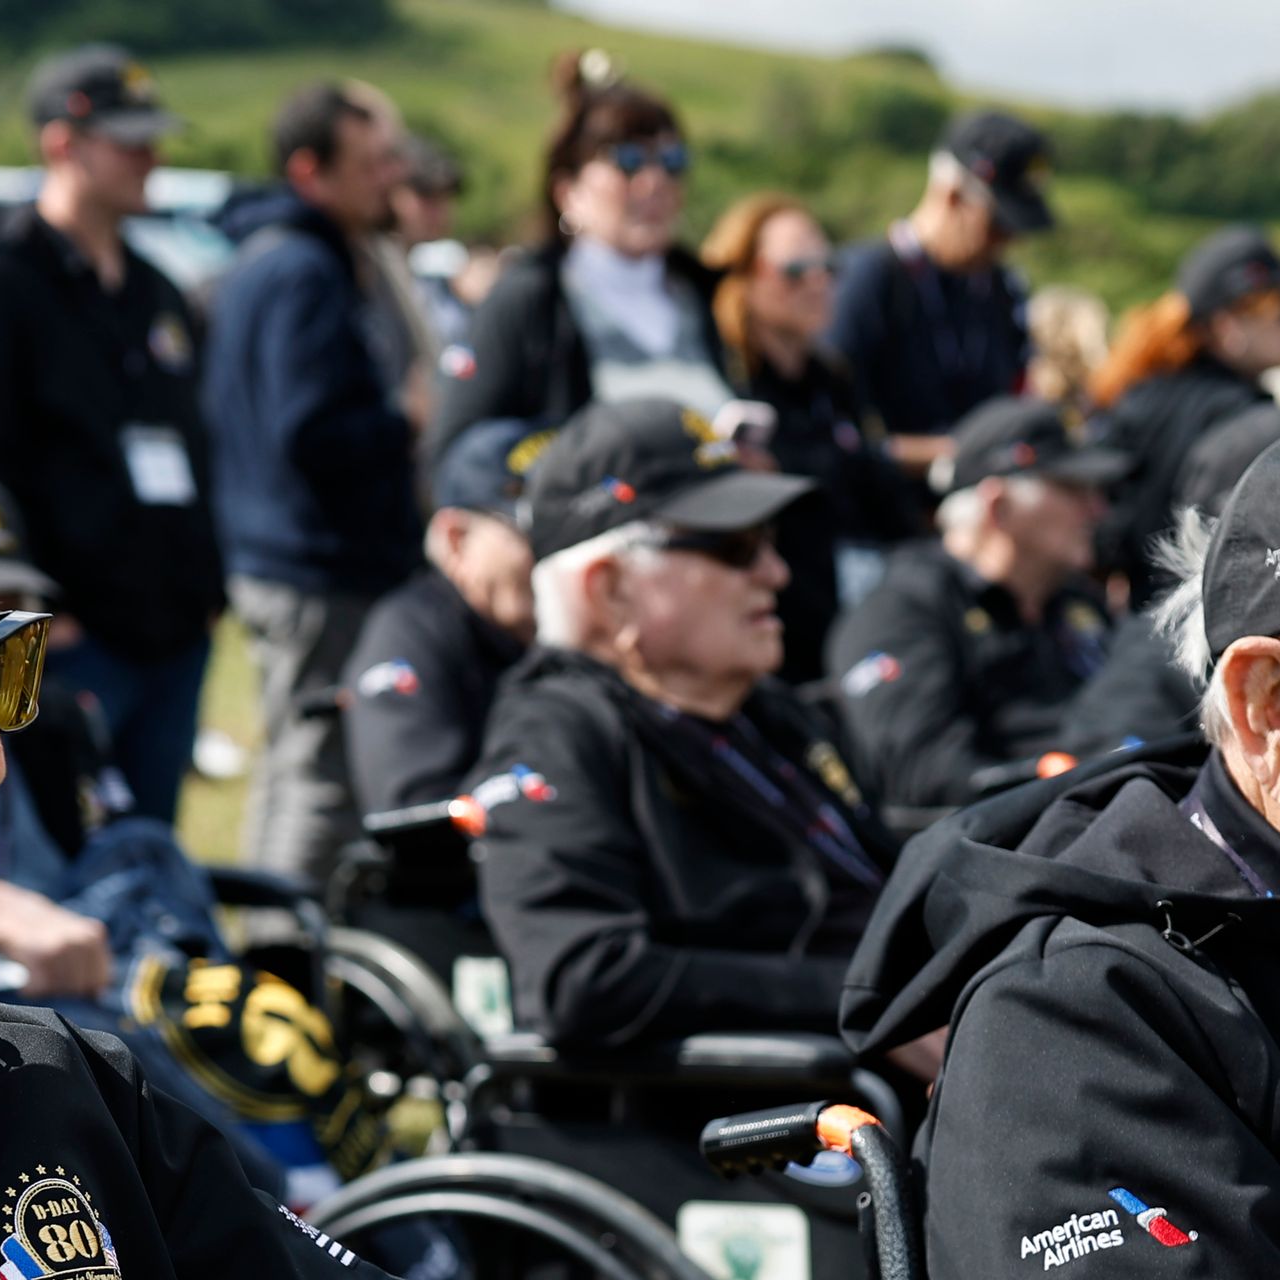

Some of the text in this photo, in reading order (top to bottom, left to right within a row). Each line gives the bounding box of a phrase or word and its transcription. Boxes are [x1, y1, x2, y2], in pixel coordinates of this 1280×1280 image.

[30, 1197, 81, 1221] D-DAY
[38, 1219, 100, 1263] 80
[1021, 1209, 1120, 1259] American
[1043, 1229, 1125, 1271] Airlines
